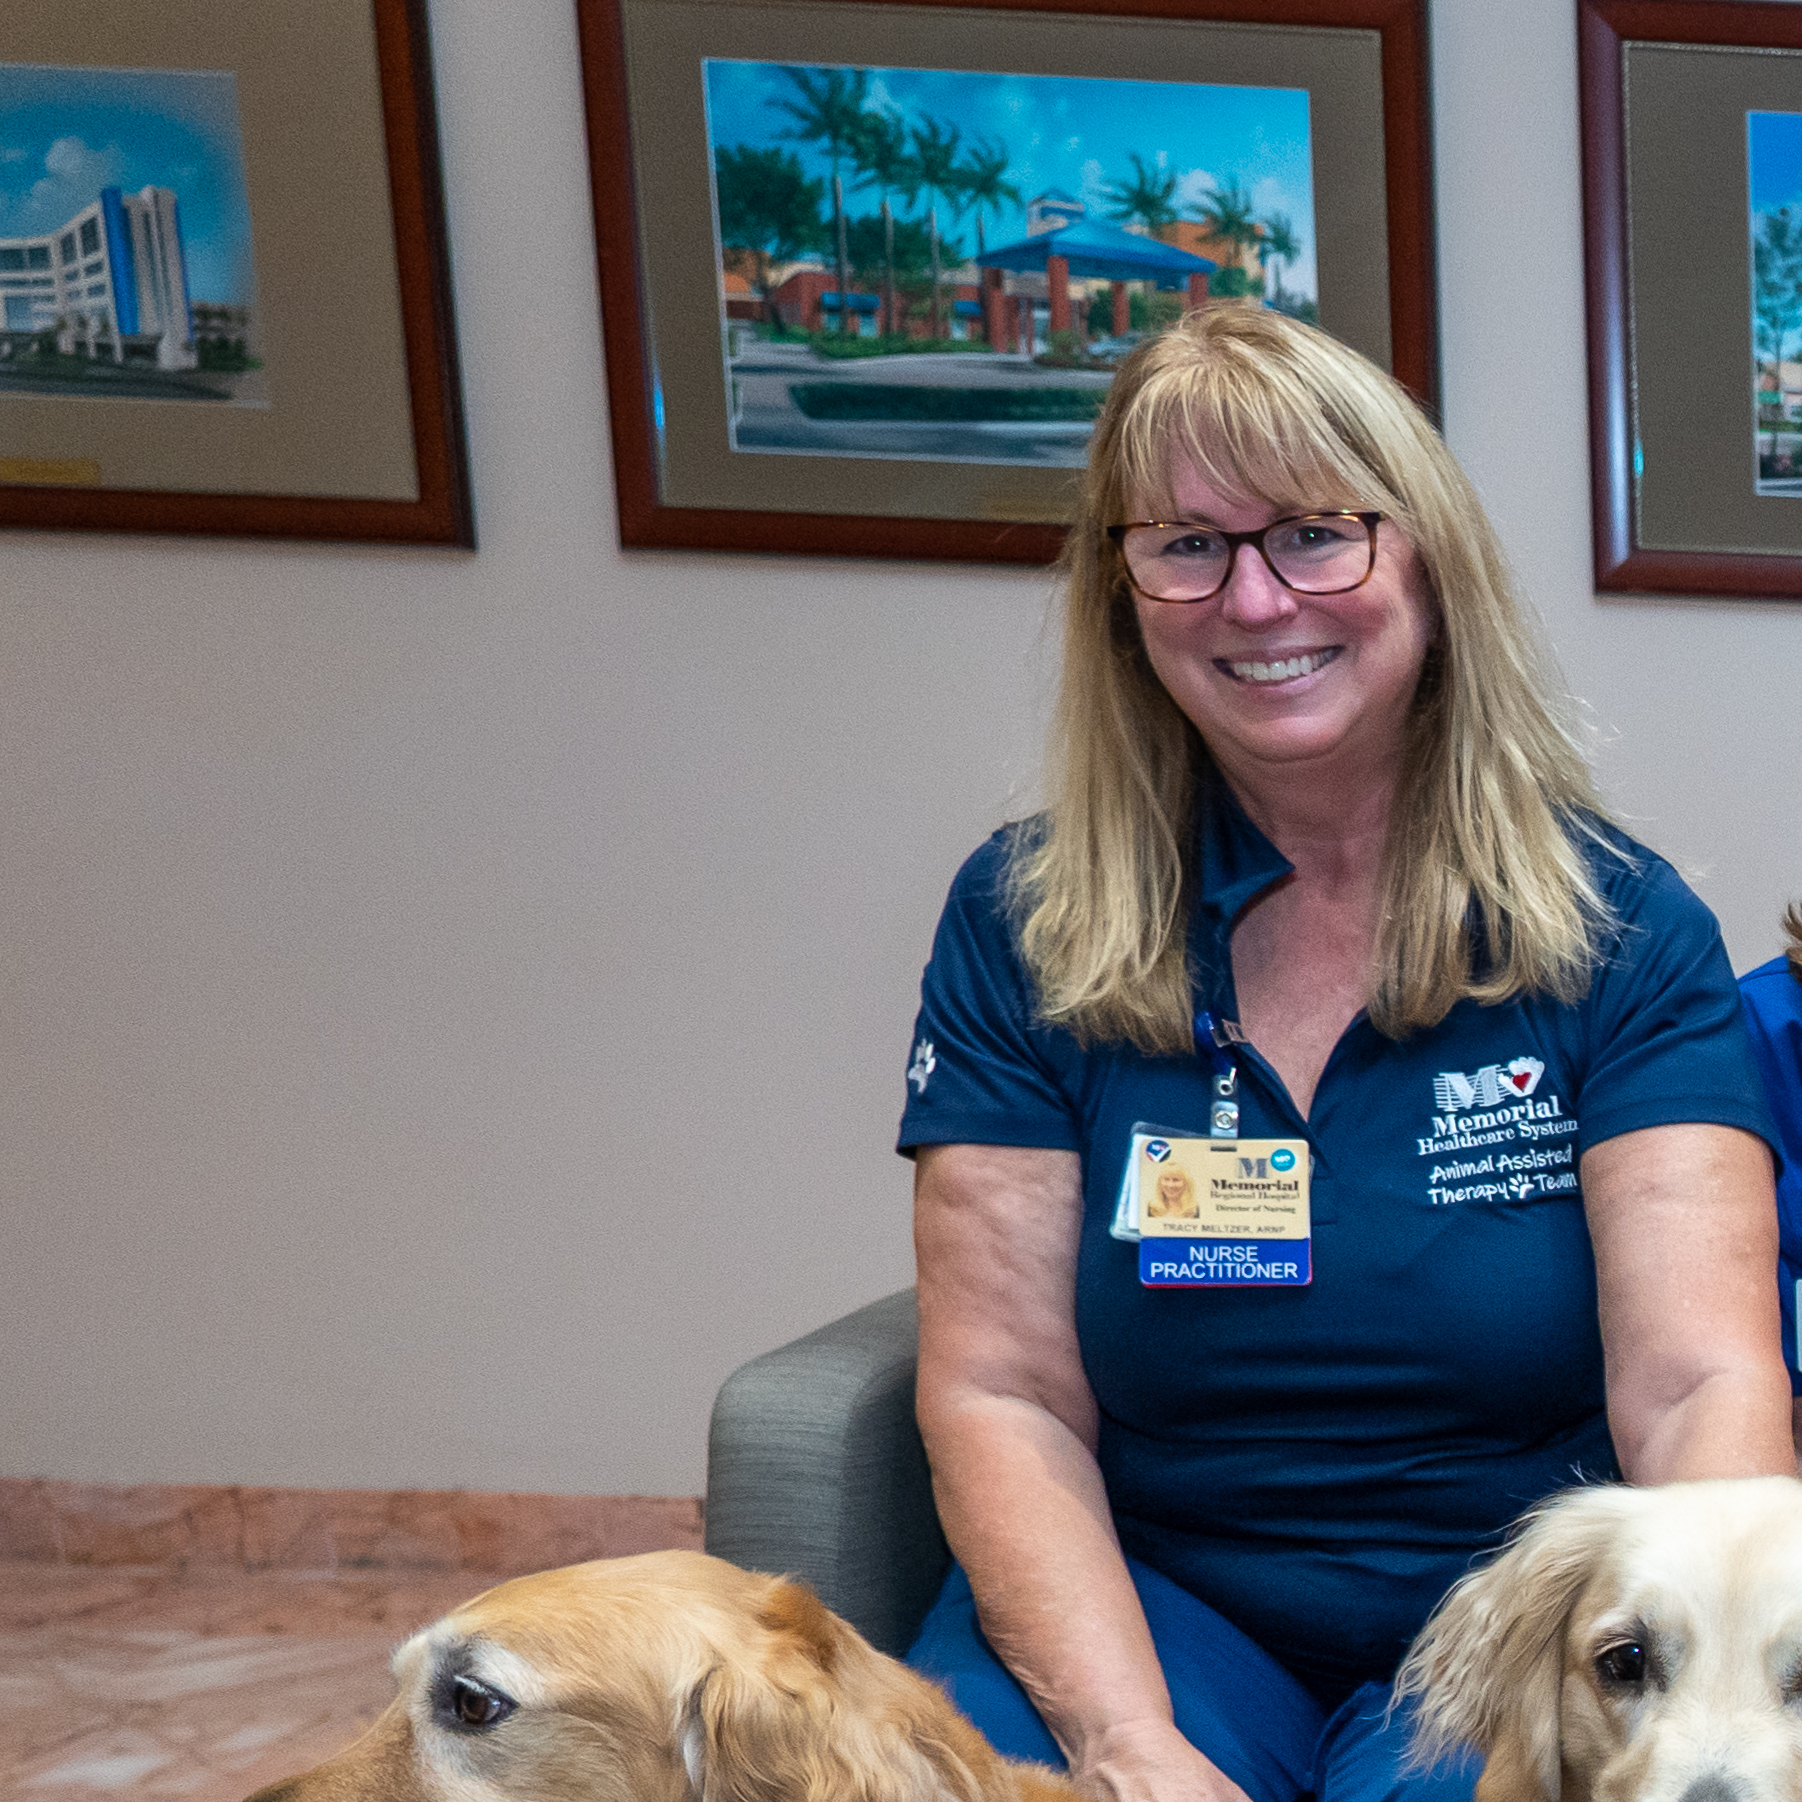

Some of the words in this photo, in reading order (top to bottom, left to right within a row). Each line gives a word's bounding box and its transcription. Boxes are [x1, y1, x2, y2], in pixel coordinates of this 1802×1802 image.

[1431, 1095, 1563, 1137] Memorial
[1416, 1127, 1516, 1156] Healthcare
[1518, 1119, 1579, 1140] System
[1429, 1155, 1495, 1184] Animal
[1495, 1143, 1573, 1173] Assisted
[1211, 1178, 1299, 1192] Memorial
[1427, 1181, 1511, 1205] Therapy
[1533, 1172, 1578, 1192] Team
[1210, 1191, 1255, 1201] Regional
[1259, 1191, 1300, 1201] Hospital
[1163, 1223, 1198, 1232] TRACY
[1189, 1246, 1259, 1262] NURSE
[1150, 1262, 1298, 1279] PRACTITIONER
